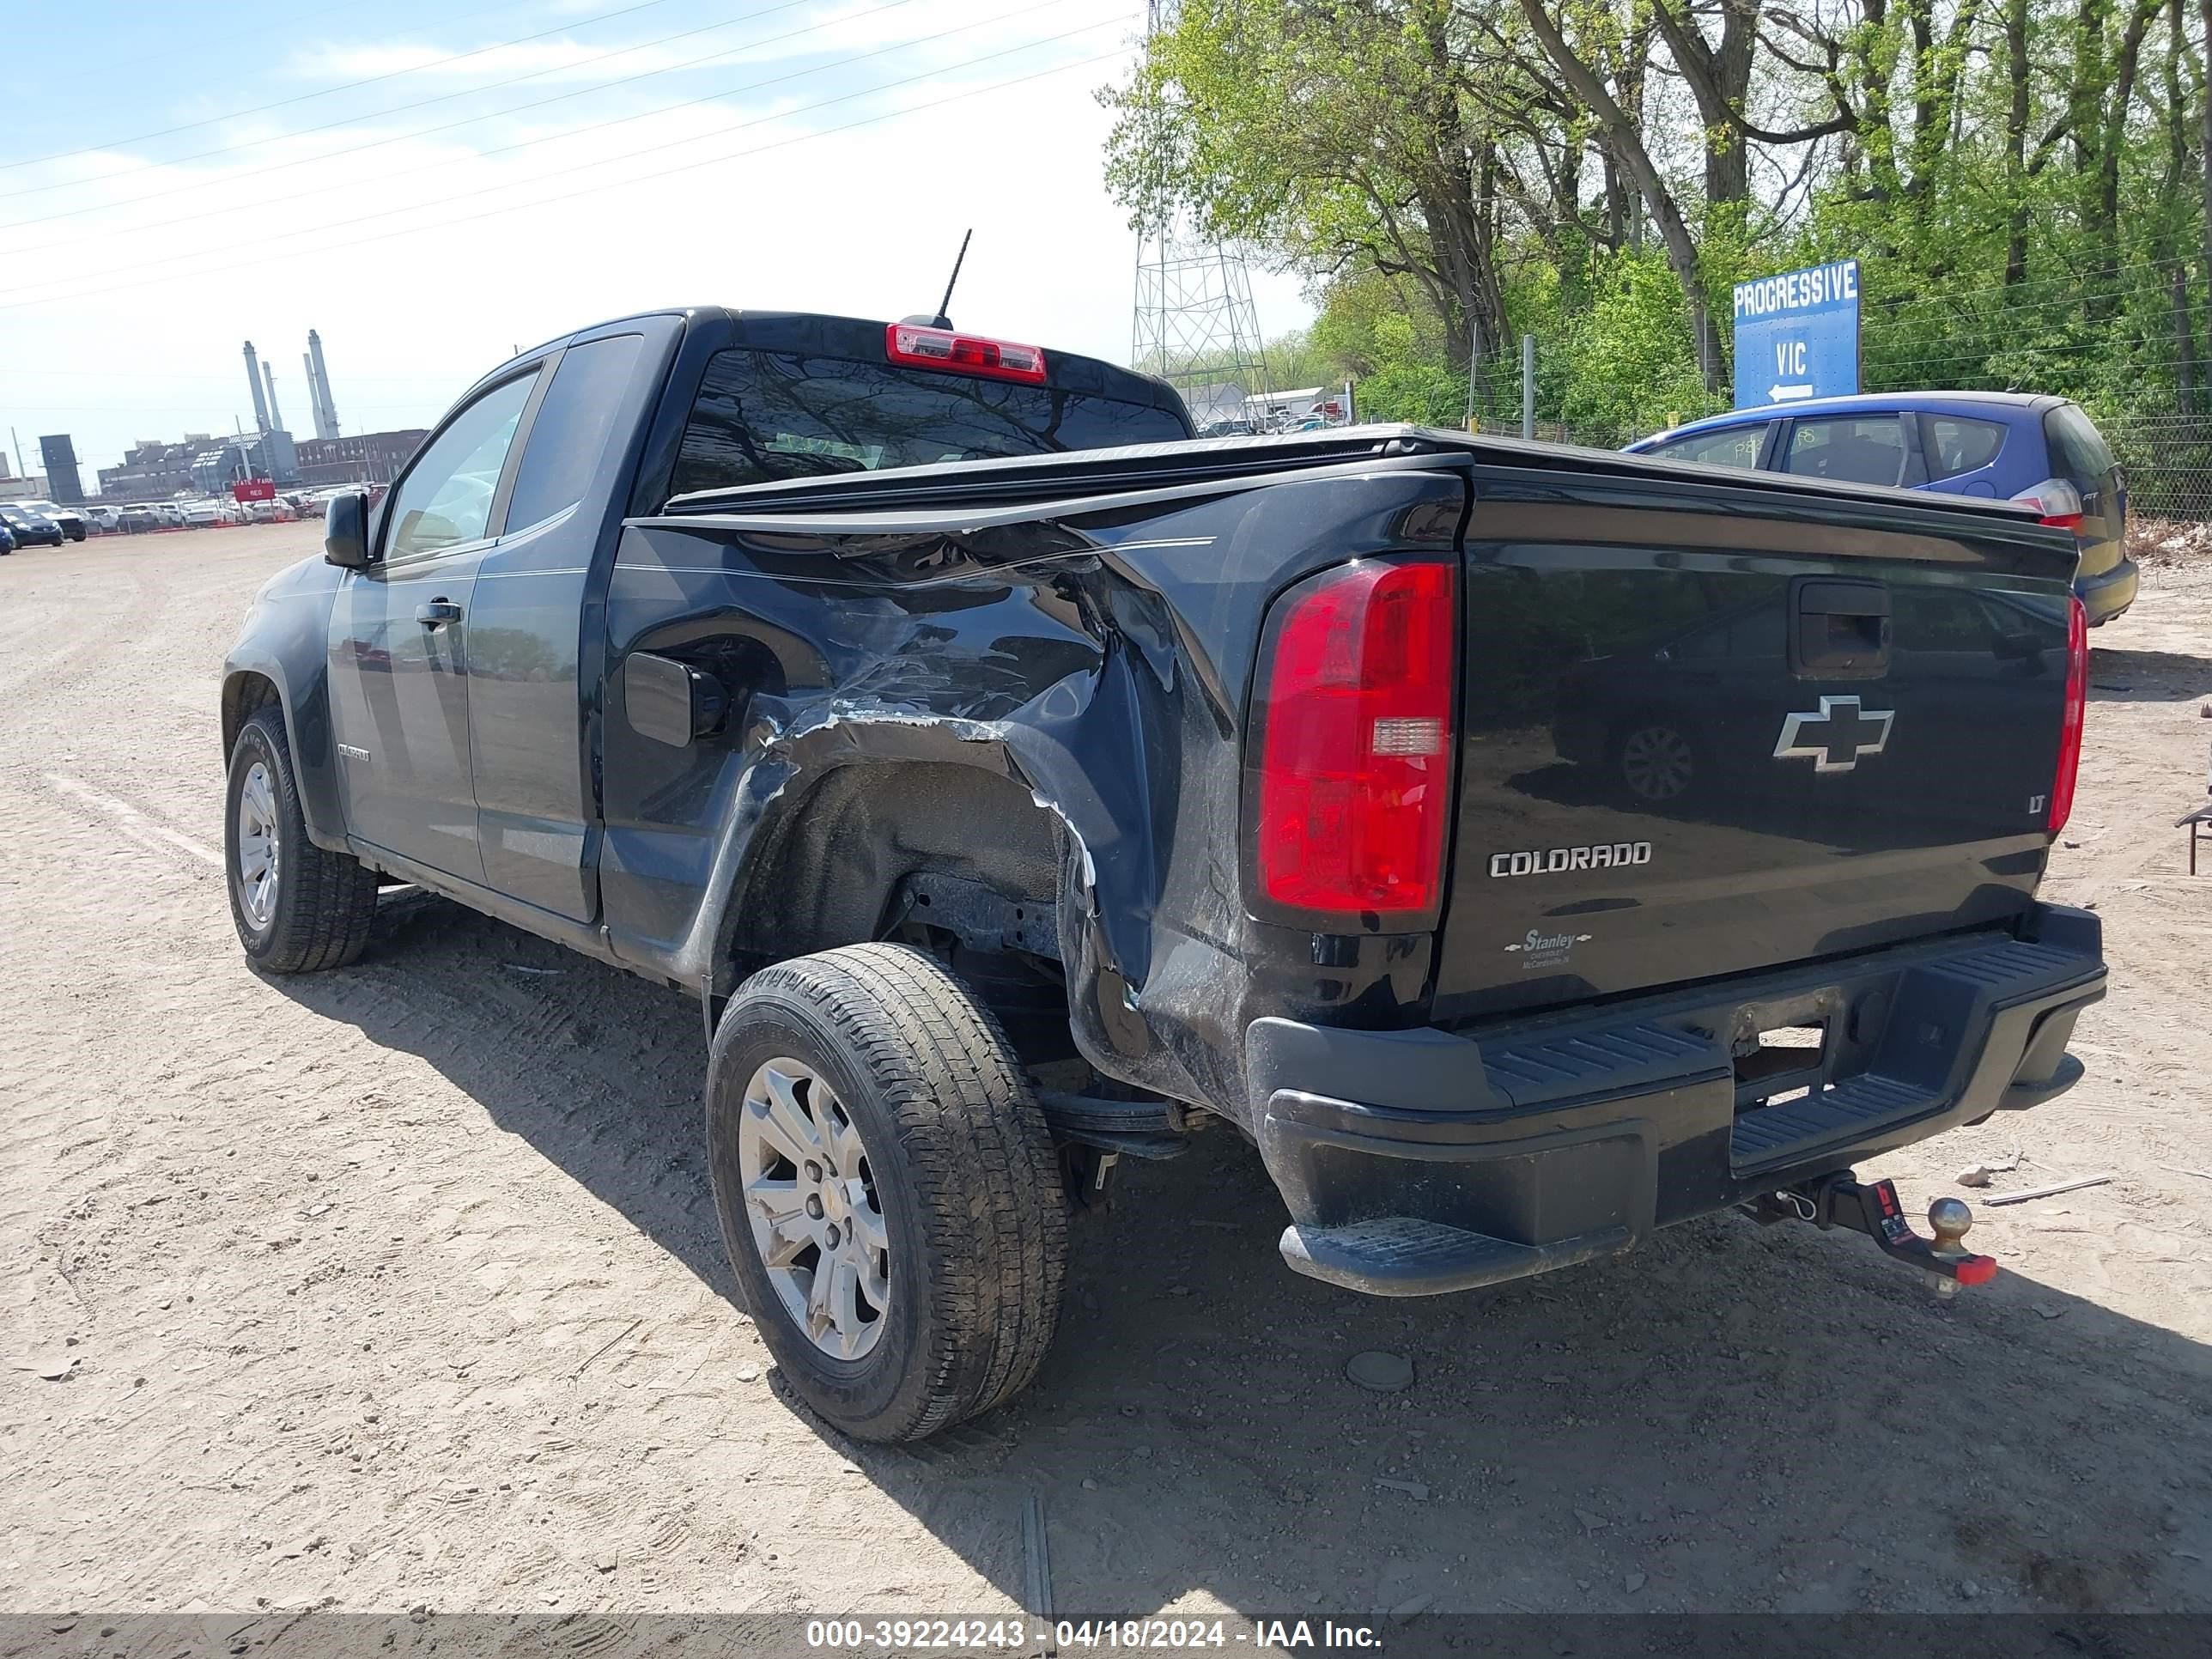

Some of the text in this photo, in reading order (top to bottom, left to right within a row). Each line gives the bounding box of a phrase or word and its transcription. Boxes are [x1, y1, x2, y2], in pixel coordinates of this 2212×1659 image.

[1734, 261, 1857, 318] PROGRESSIVE
[1776, 342, 1807, 376] VIC
[2028, 794, 2045, 814] LT
[1489, 841, 1652, 878] COLORADO
[1523, 928, 1576, 951] Stanley
